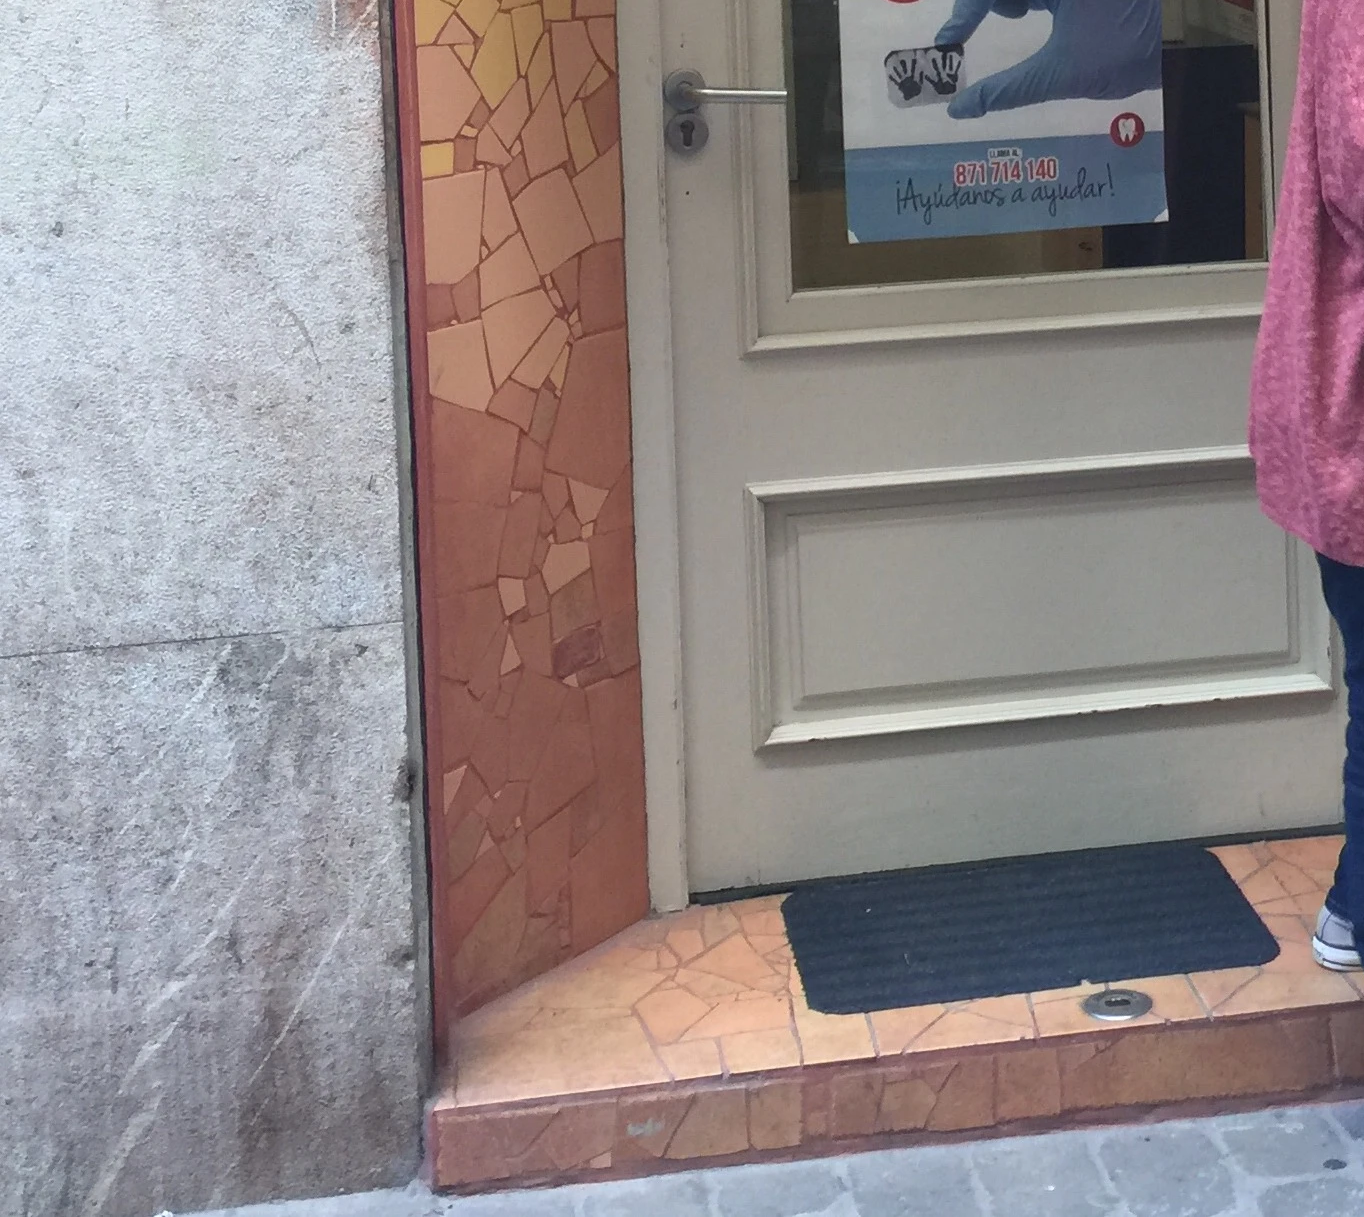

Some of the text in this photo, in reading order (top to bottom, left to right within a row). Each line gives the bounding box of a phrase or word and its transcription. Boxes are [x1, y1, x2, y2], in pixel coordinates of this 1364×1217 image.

[953, 158, 1058, 187] 871 714 140
[1011, 188, 1027, 203] a
[1030, 163, 1115, 216] ayudar!
